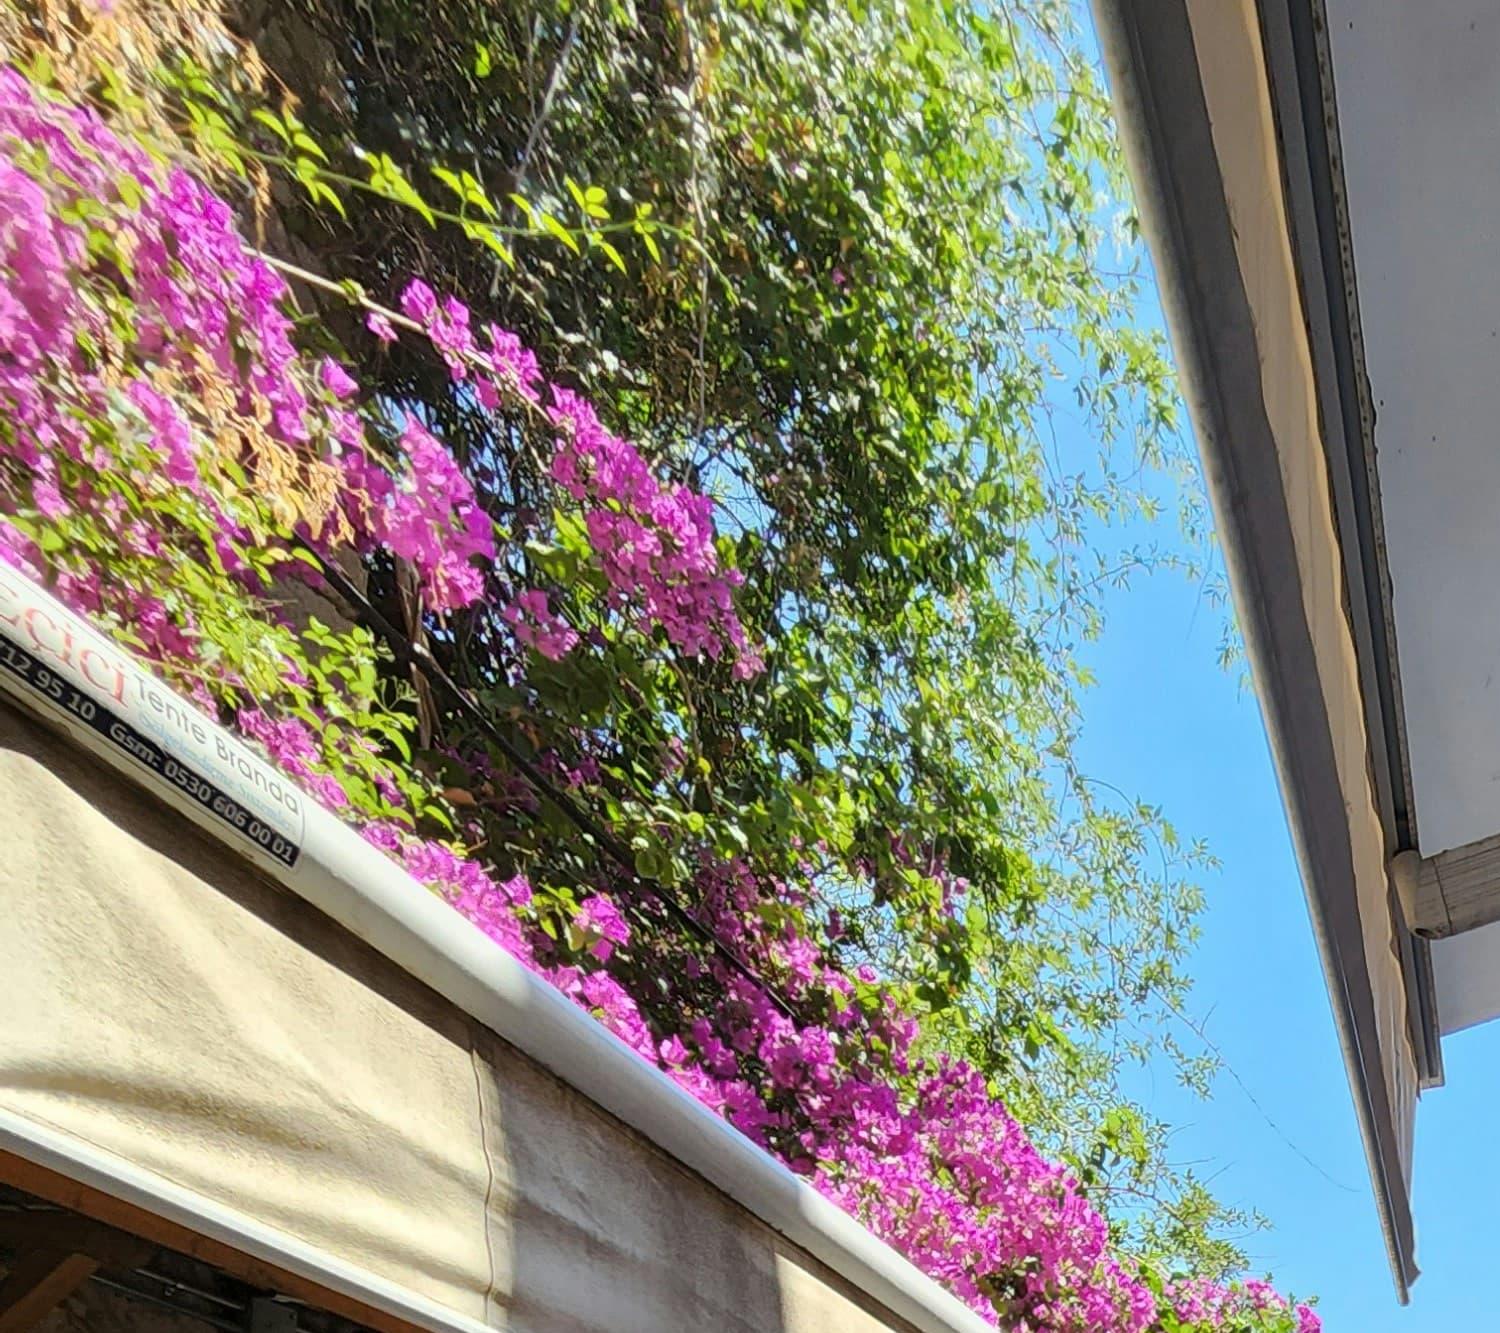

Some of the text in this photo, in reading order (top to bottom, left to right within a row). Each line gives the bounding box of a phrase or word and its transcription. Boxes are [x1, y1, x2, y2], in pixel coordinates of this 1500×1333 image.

[0, 641, 294, 863] 12 95 10 Gsm: 0530 606 00 01
[133, 674, 299, 816] Tente Branda
